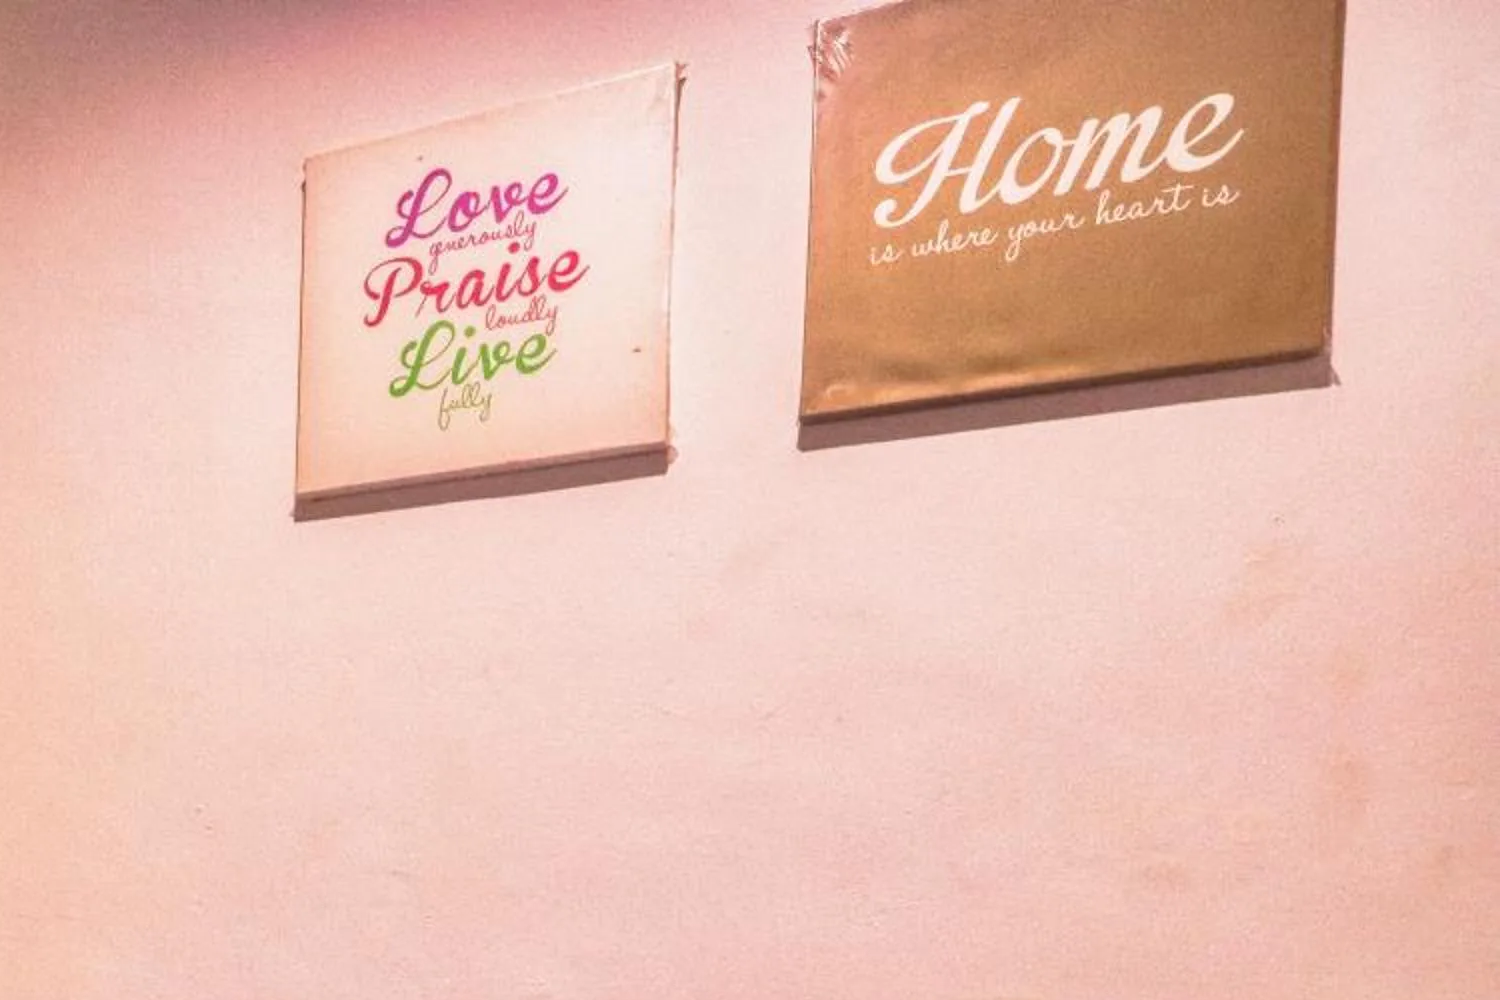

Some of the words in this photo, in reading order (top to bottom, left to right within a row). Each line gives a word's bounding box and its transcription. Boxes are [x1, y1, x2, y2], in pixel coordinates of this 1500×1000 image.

[873, 93, 1245, 228] Home
[385, 167, 569, 248] Love
[429, 210, 537, 275] generously
[870, 244, 904, 266] is
[912, 218, 1000, 254] where
[1007, 213, 1085, 262] your
[1095, 183, 1195, 225] heart
[1201, 183, 1242, 209] is
[363, 242, 590, 328] Praise
[485, 295, 559, 336] loudly
[389, 319, 558, 398] Live
[437, 382, 493, 431] fully
